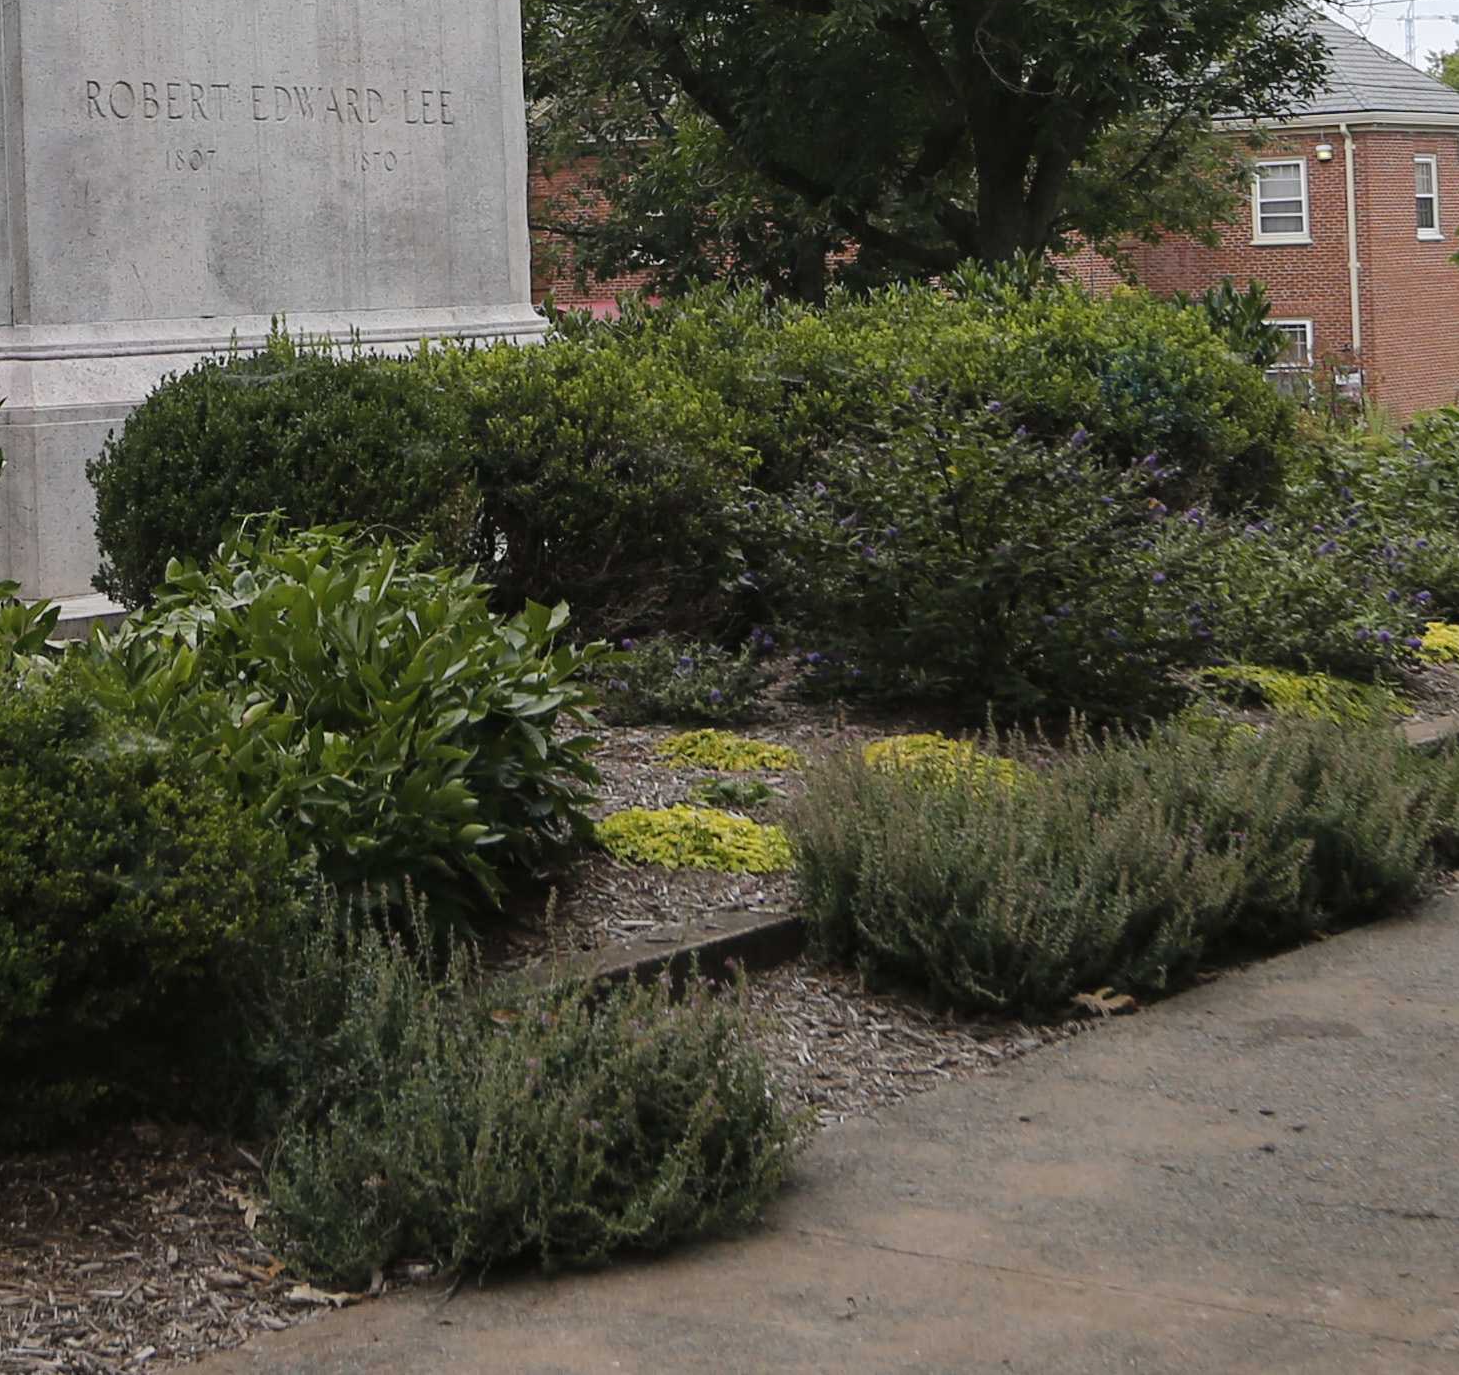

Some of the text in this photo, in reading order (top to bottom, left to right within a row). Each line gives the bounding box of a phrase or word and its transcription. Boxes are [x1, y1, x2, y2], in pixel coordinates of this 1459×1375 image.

[85, 79, 455, 126] ROBERT EDWARD LEE
[165, 148, 398, 173] 1807 1870
